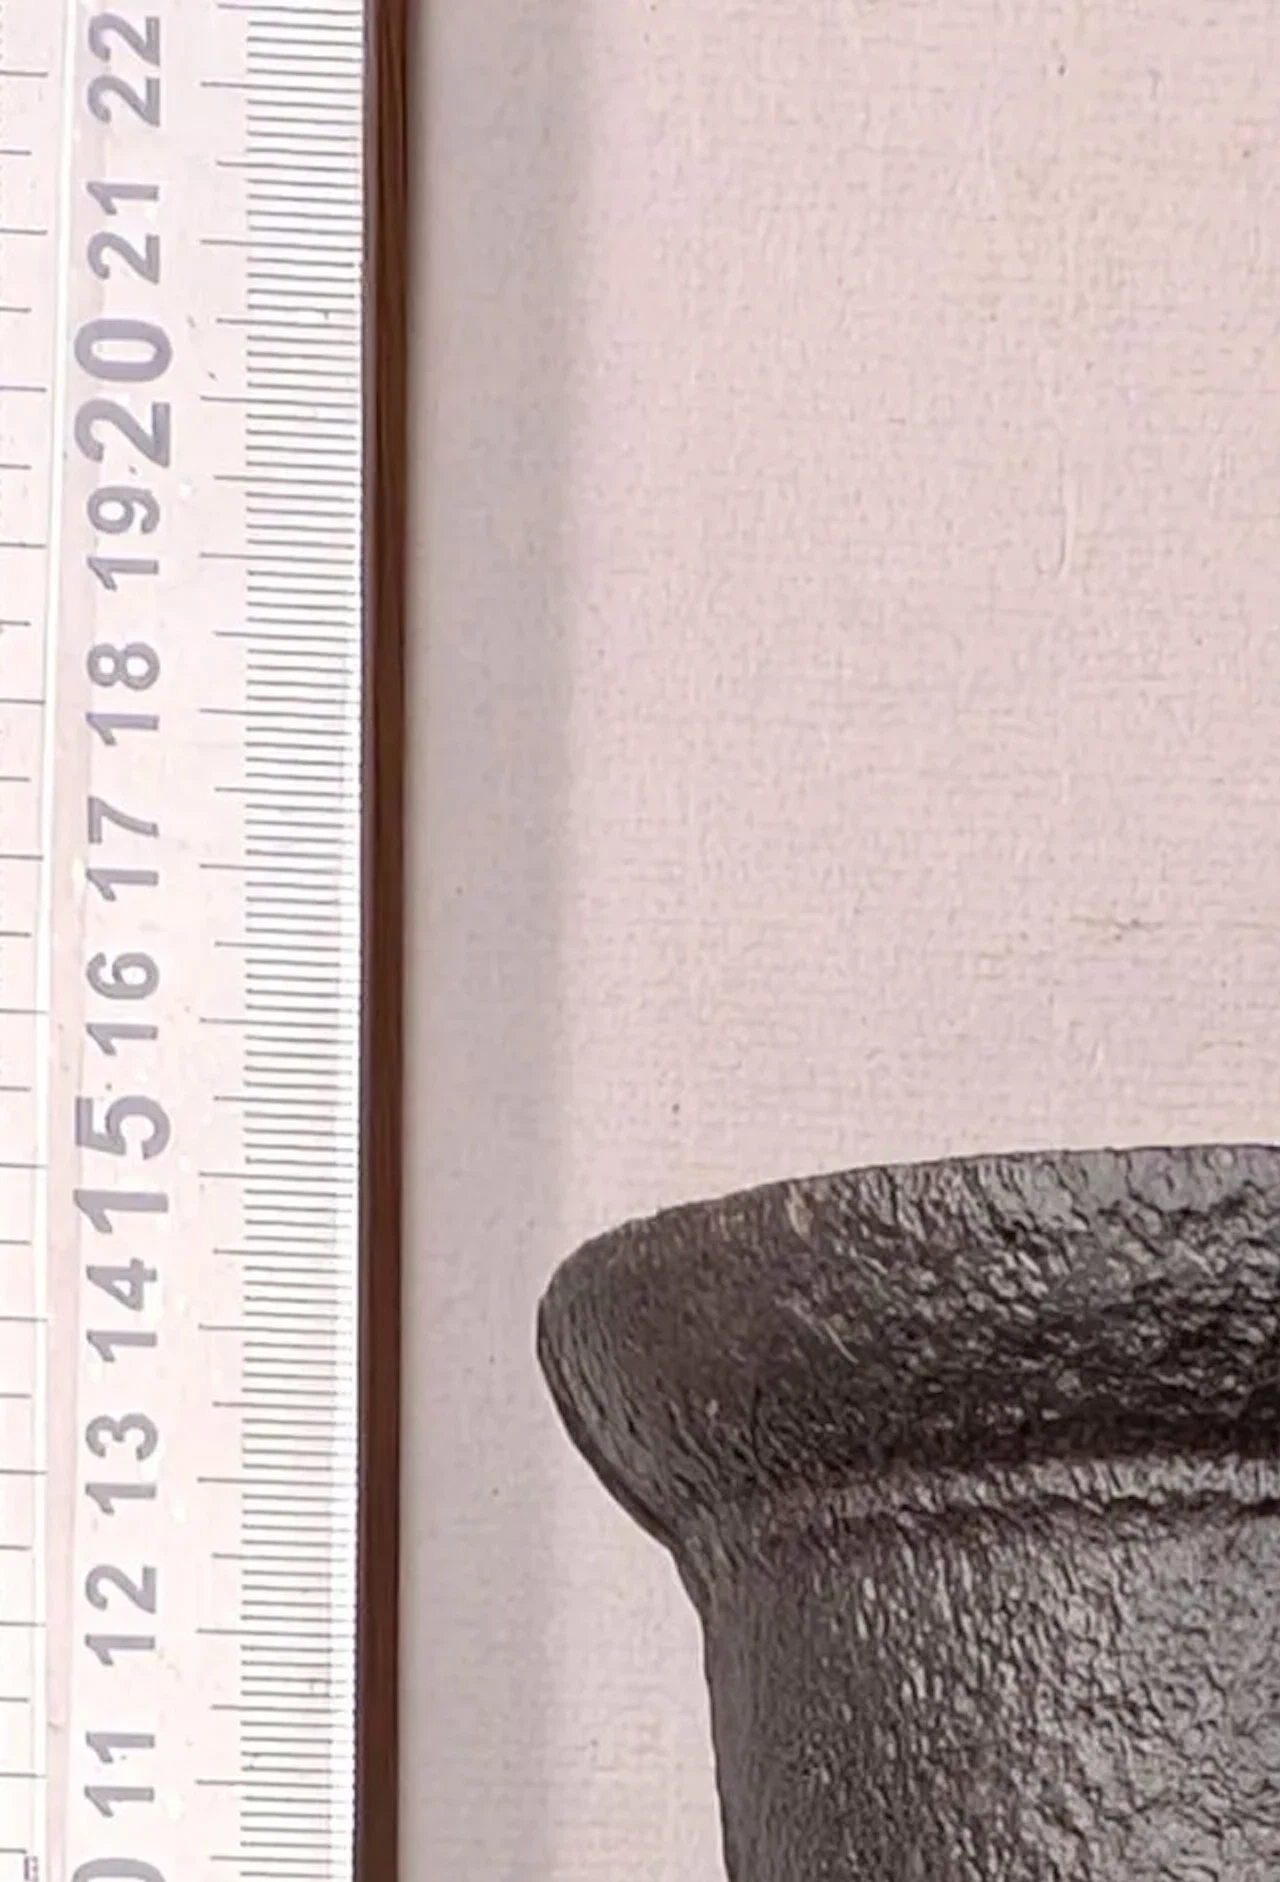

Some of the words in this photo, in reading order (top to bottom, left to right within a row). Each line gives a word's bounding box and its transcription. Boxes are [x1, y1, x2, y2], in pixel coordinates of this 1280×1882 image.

[88, 12, 161, 128] 22
[86, 180, 161, 286] 21
[74, 318, 173, 469] 20
[86, 486, 161, 592] 19
[86, 642, 161, 747] 18
[85, 795, 160, 903] 17
[85, 952, 160, 1057] 16
[73, 1095, 171, 1234] 15
[86, 1257, 158, 1364] 14
[85, 1413, 159, 1516] 13
[85, 1564, 157, 1667] 12
[84, 1731, 156, 1819] 11
